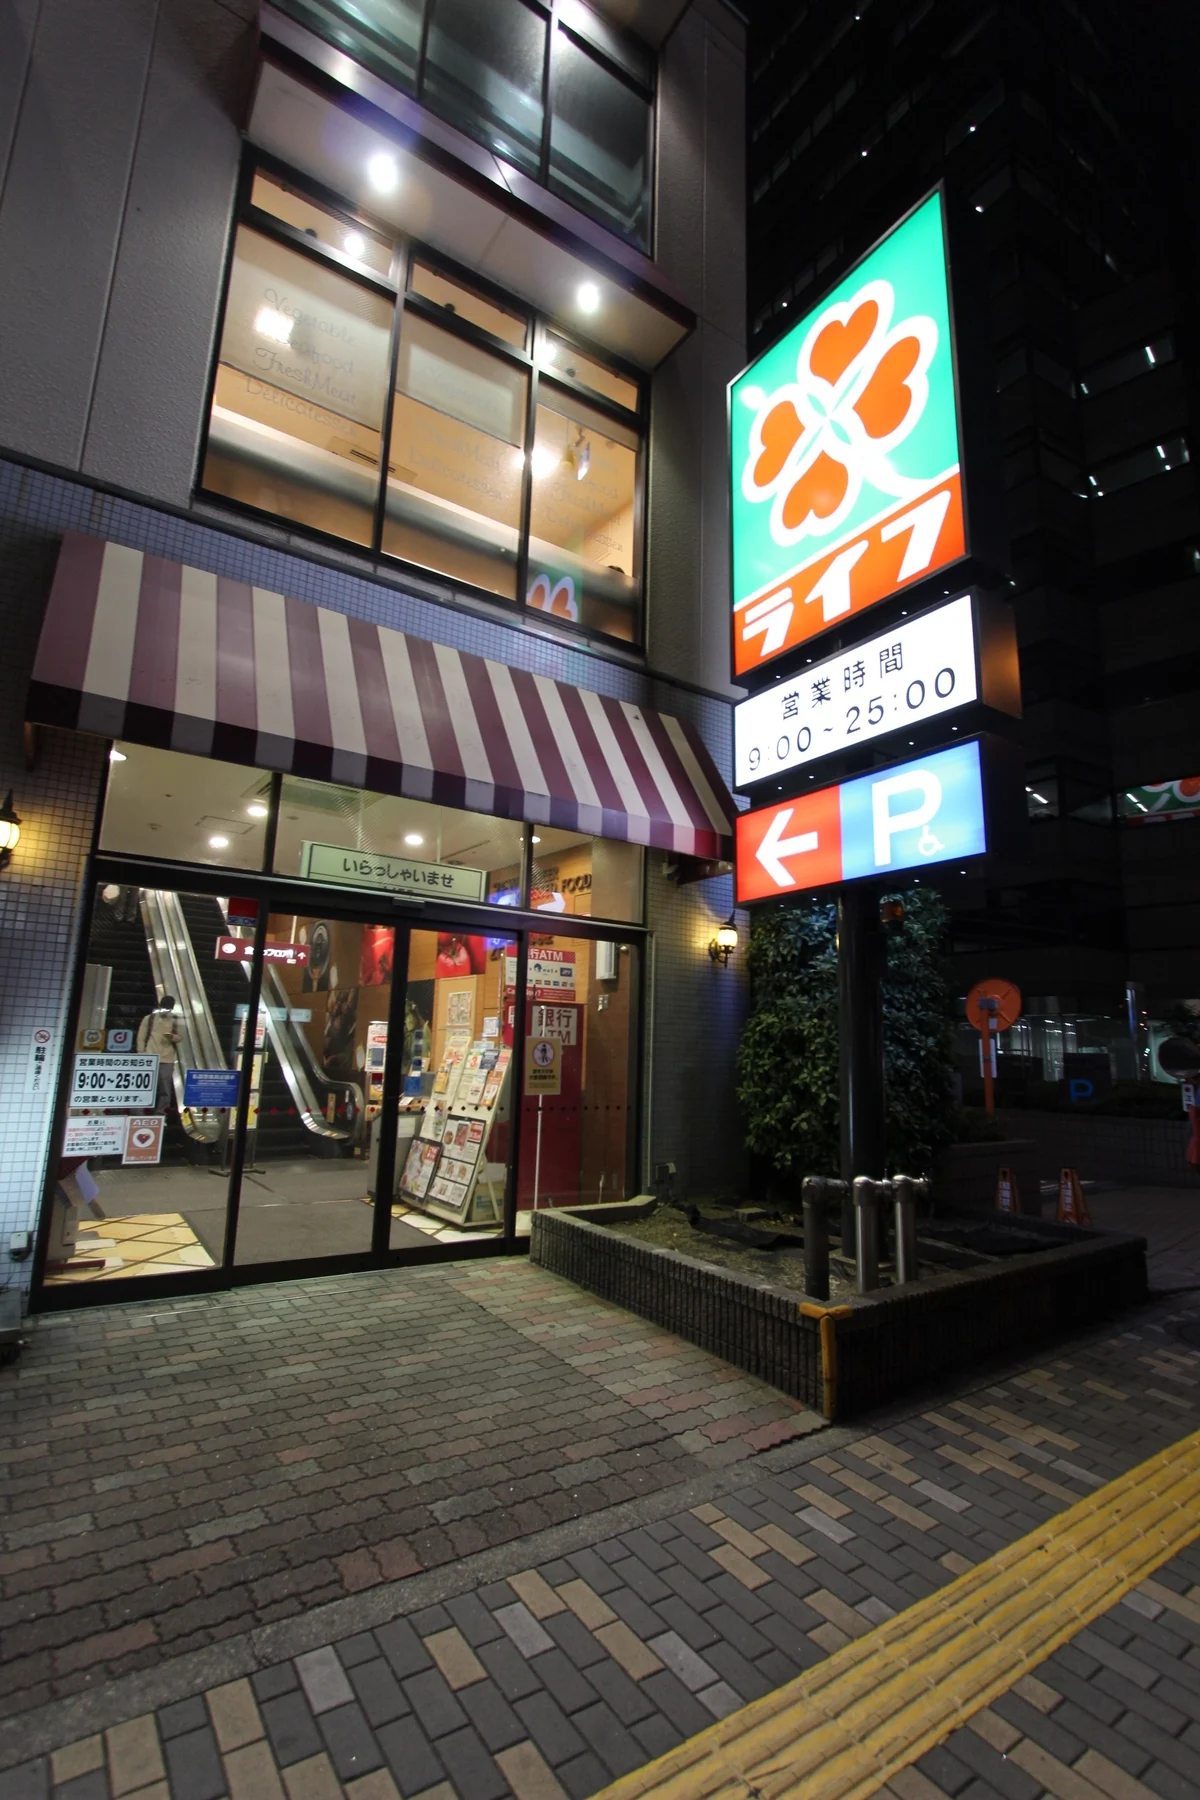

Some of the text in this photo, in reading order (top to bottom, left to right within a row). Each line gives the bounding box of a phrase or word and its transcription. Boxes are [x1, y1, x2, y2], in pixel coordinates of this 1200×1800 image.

[264, 288, 359, 347] Vegetable
[742, 490, 952, 657] ライフ
[781, 641, 904, 720] 営業時間
[872, 768, 943, 867] P
[342, 857, 455, 888] いらっしゃいませ
[528, 948, 563, 961] 行ATM
[538, 1009, 573, 1029] 銀行
[540, 1030, 571, 1044] TM
[79, 1058, 153, 1067] 営業時間のお知らせ
[74, 1095, 143, 1103] の営業となります。
